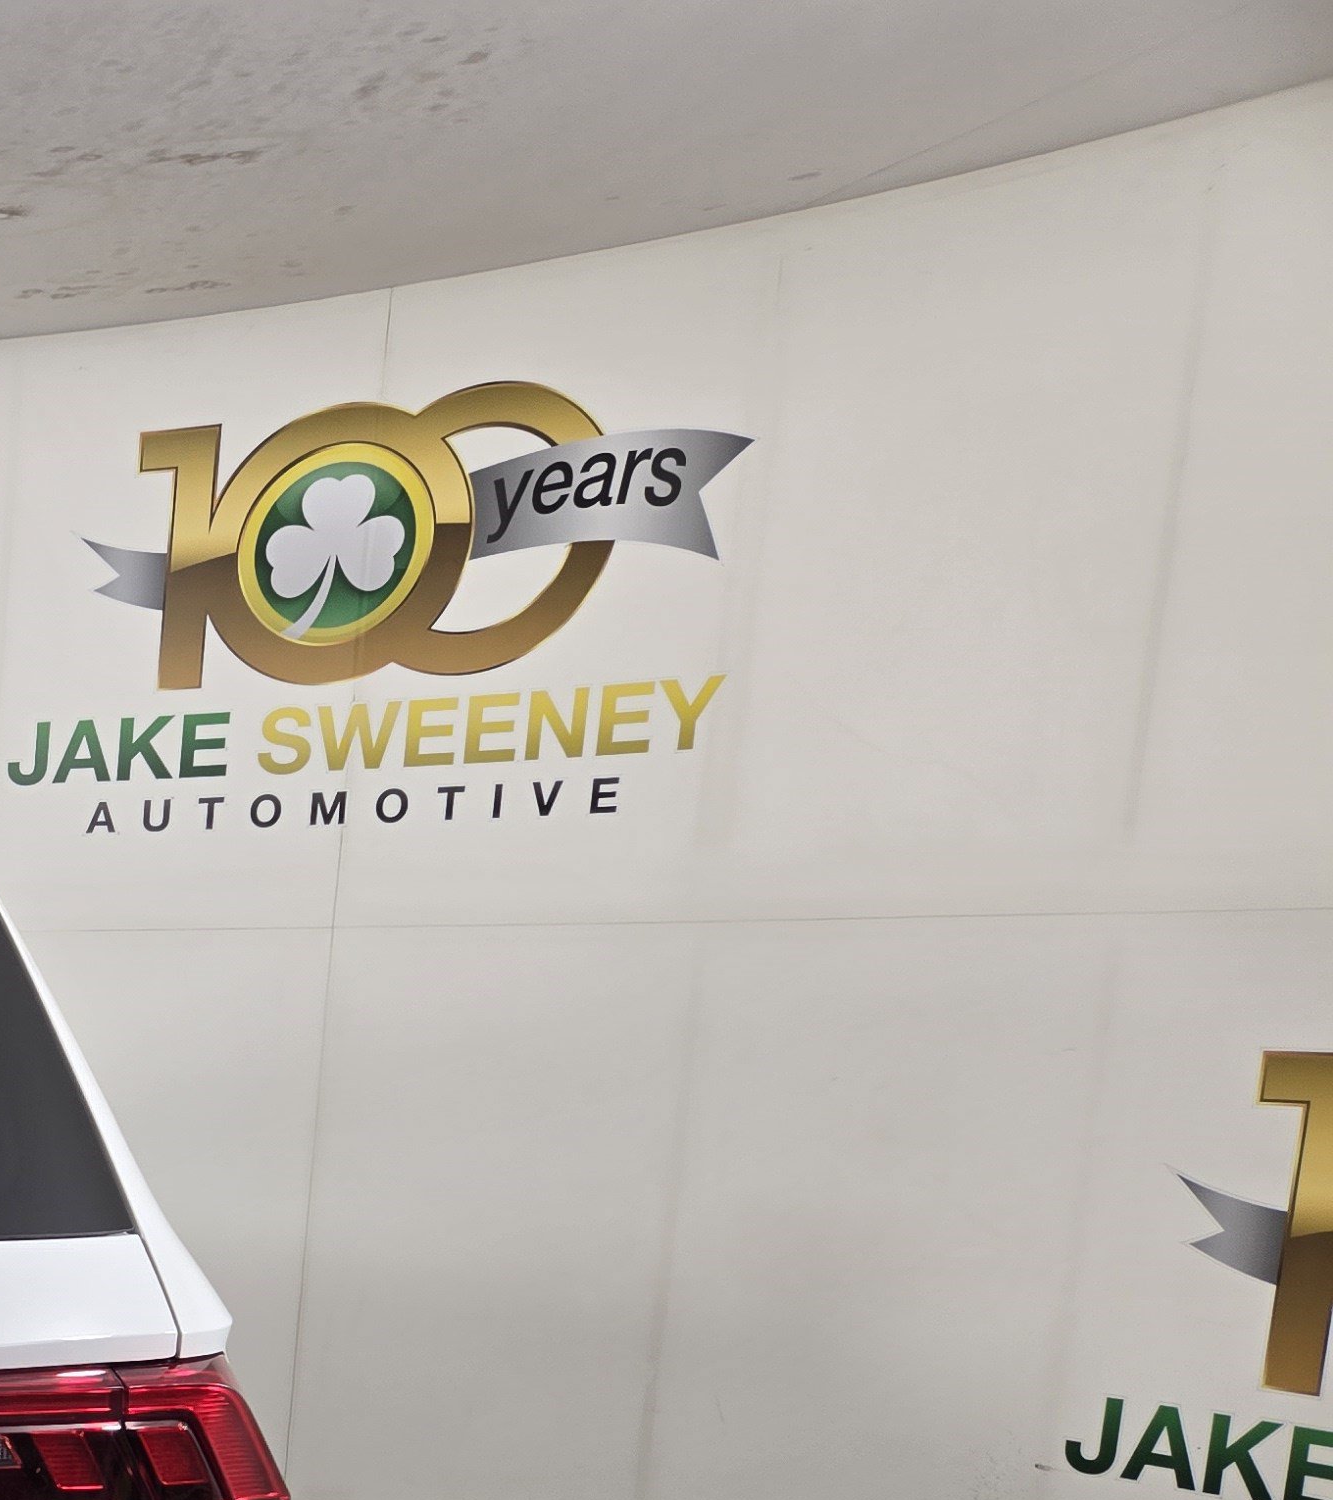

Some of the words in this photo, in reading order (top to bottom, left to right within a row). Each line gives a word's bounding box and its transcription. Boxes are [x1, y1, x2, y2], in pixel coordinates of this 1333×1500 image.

[139, 380, 616, 691] 100
[485, 444, 688, 544] years
[7, 711, 231, 787] JAKE
[257, 674, 727, 775] SWEENEY
[86, 776, 622, 835] AUTOMOTIVE
